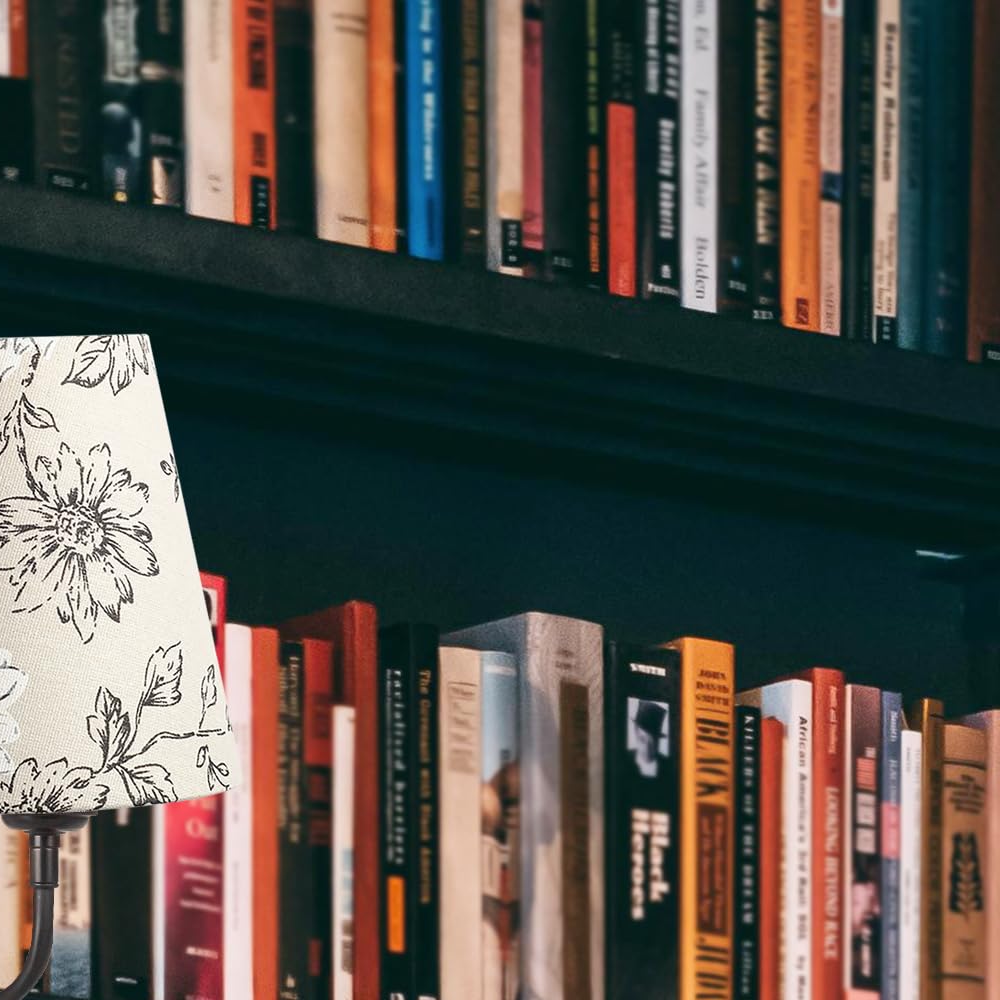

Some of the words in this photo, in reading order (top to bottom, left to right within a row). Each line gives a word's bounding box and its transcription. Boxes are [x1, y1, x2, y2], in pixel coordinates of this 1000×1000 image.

[880, 22, 897, 91] Stanley
[423, 92, 436, 180] Wilderness
[692, 88, 709, 148] Family
[882, 97, 897, 182] Robinson
[692, 153, 709, 207] Affair
[694, 236, 709, 300] Bolden
[419, 669, 432, 694] The
[696, 717, 730, 801] BLACK
[742, 715, 754, 788] KILLERS
[797, 716, 808, 767] African
[742, 795, 754, 816] OF
[824, 786, 840, 852] LOOKING
[630, 808, 650, 921] Heroes
[649, 811, 670, 903] Black
[742, 825, 754, 857] THE
[742, 864, 754, 925] DREAM
[824, 857, 840, 927] BEYOND
[824, 932, 840, 961] RACE
